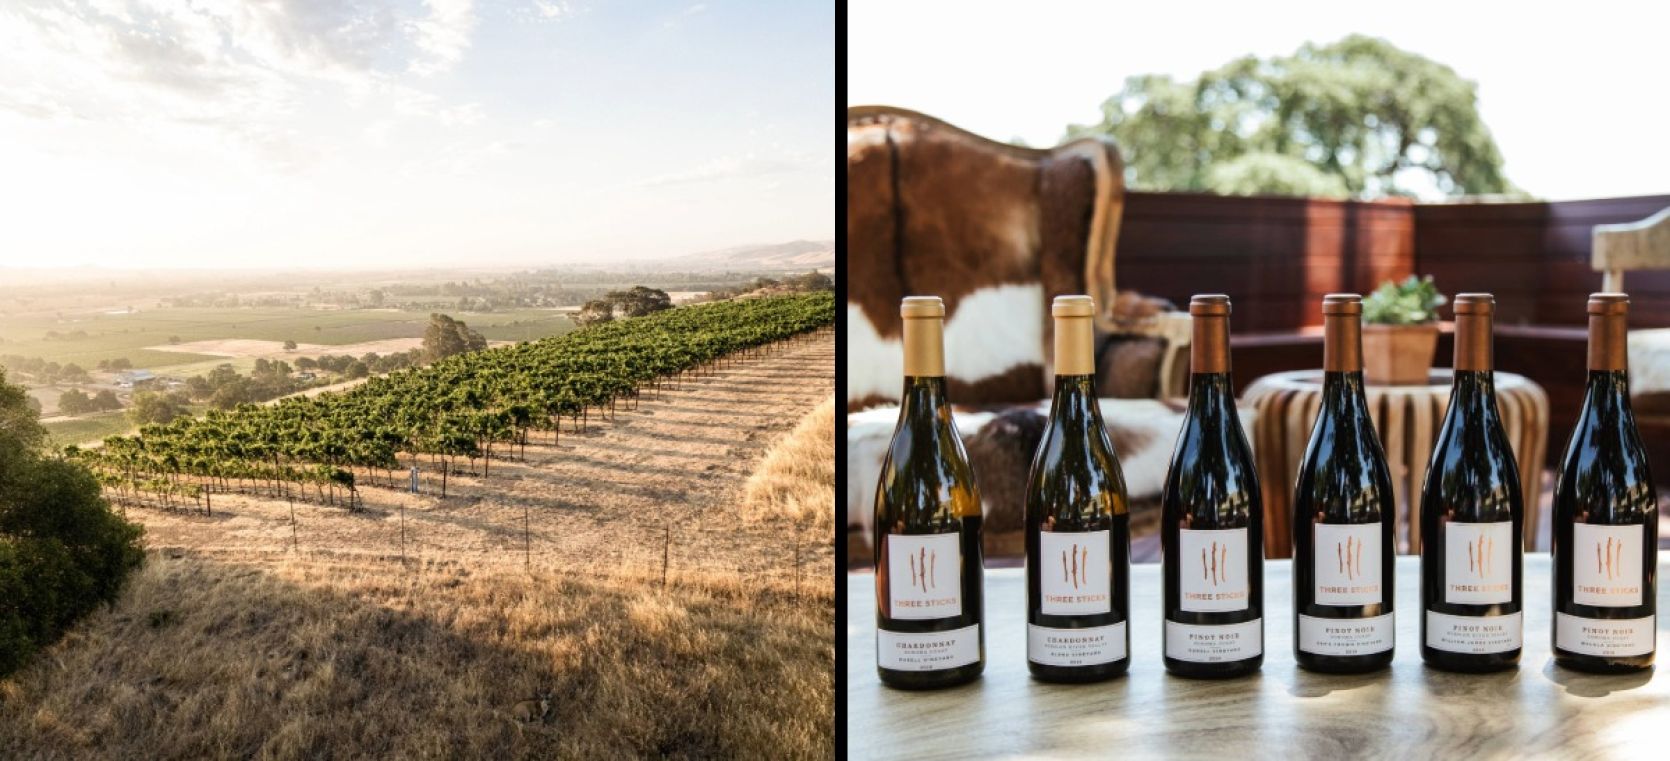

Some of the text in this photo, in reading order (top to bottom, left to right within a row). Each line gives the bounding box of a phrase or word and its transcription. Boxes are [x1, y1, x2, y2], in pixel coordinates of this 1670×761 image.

[1320, 585, 1379, 594] THREE STICKS
[1578, 585, 1638, 594] THREE STICKS
[1046, 595, 1106, 603] THREE STICKS
[1185, 591, 1244, 600] THREE STICKS
[895, 598, 956, 608] THREE STICKS
[896, 640, 956, 649] CHARDONNAY
